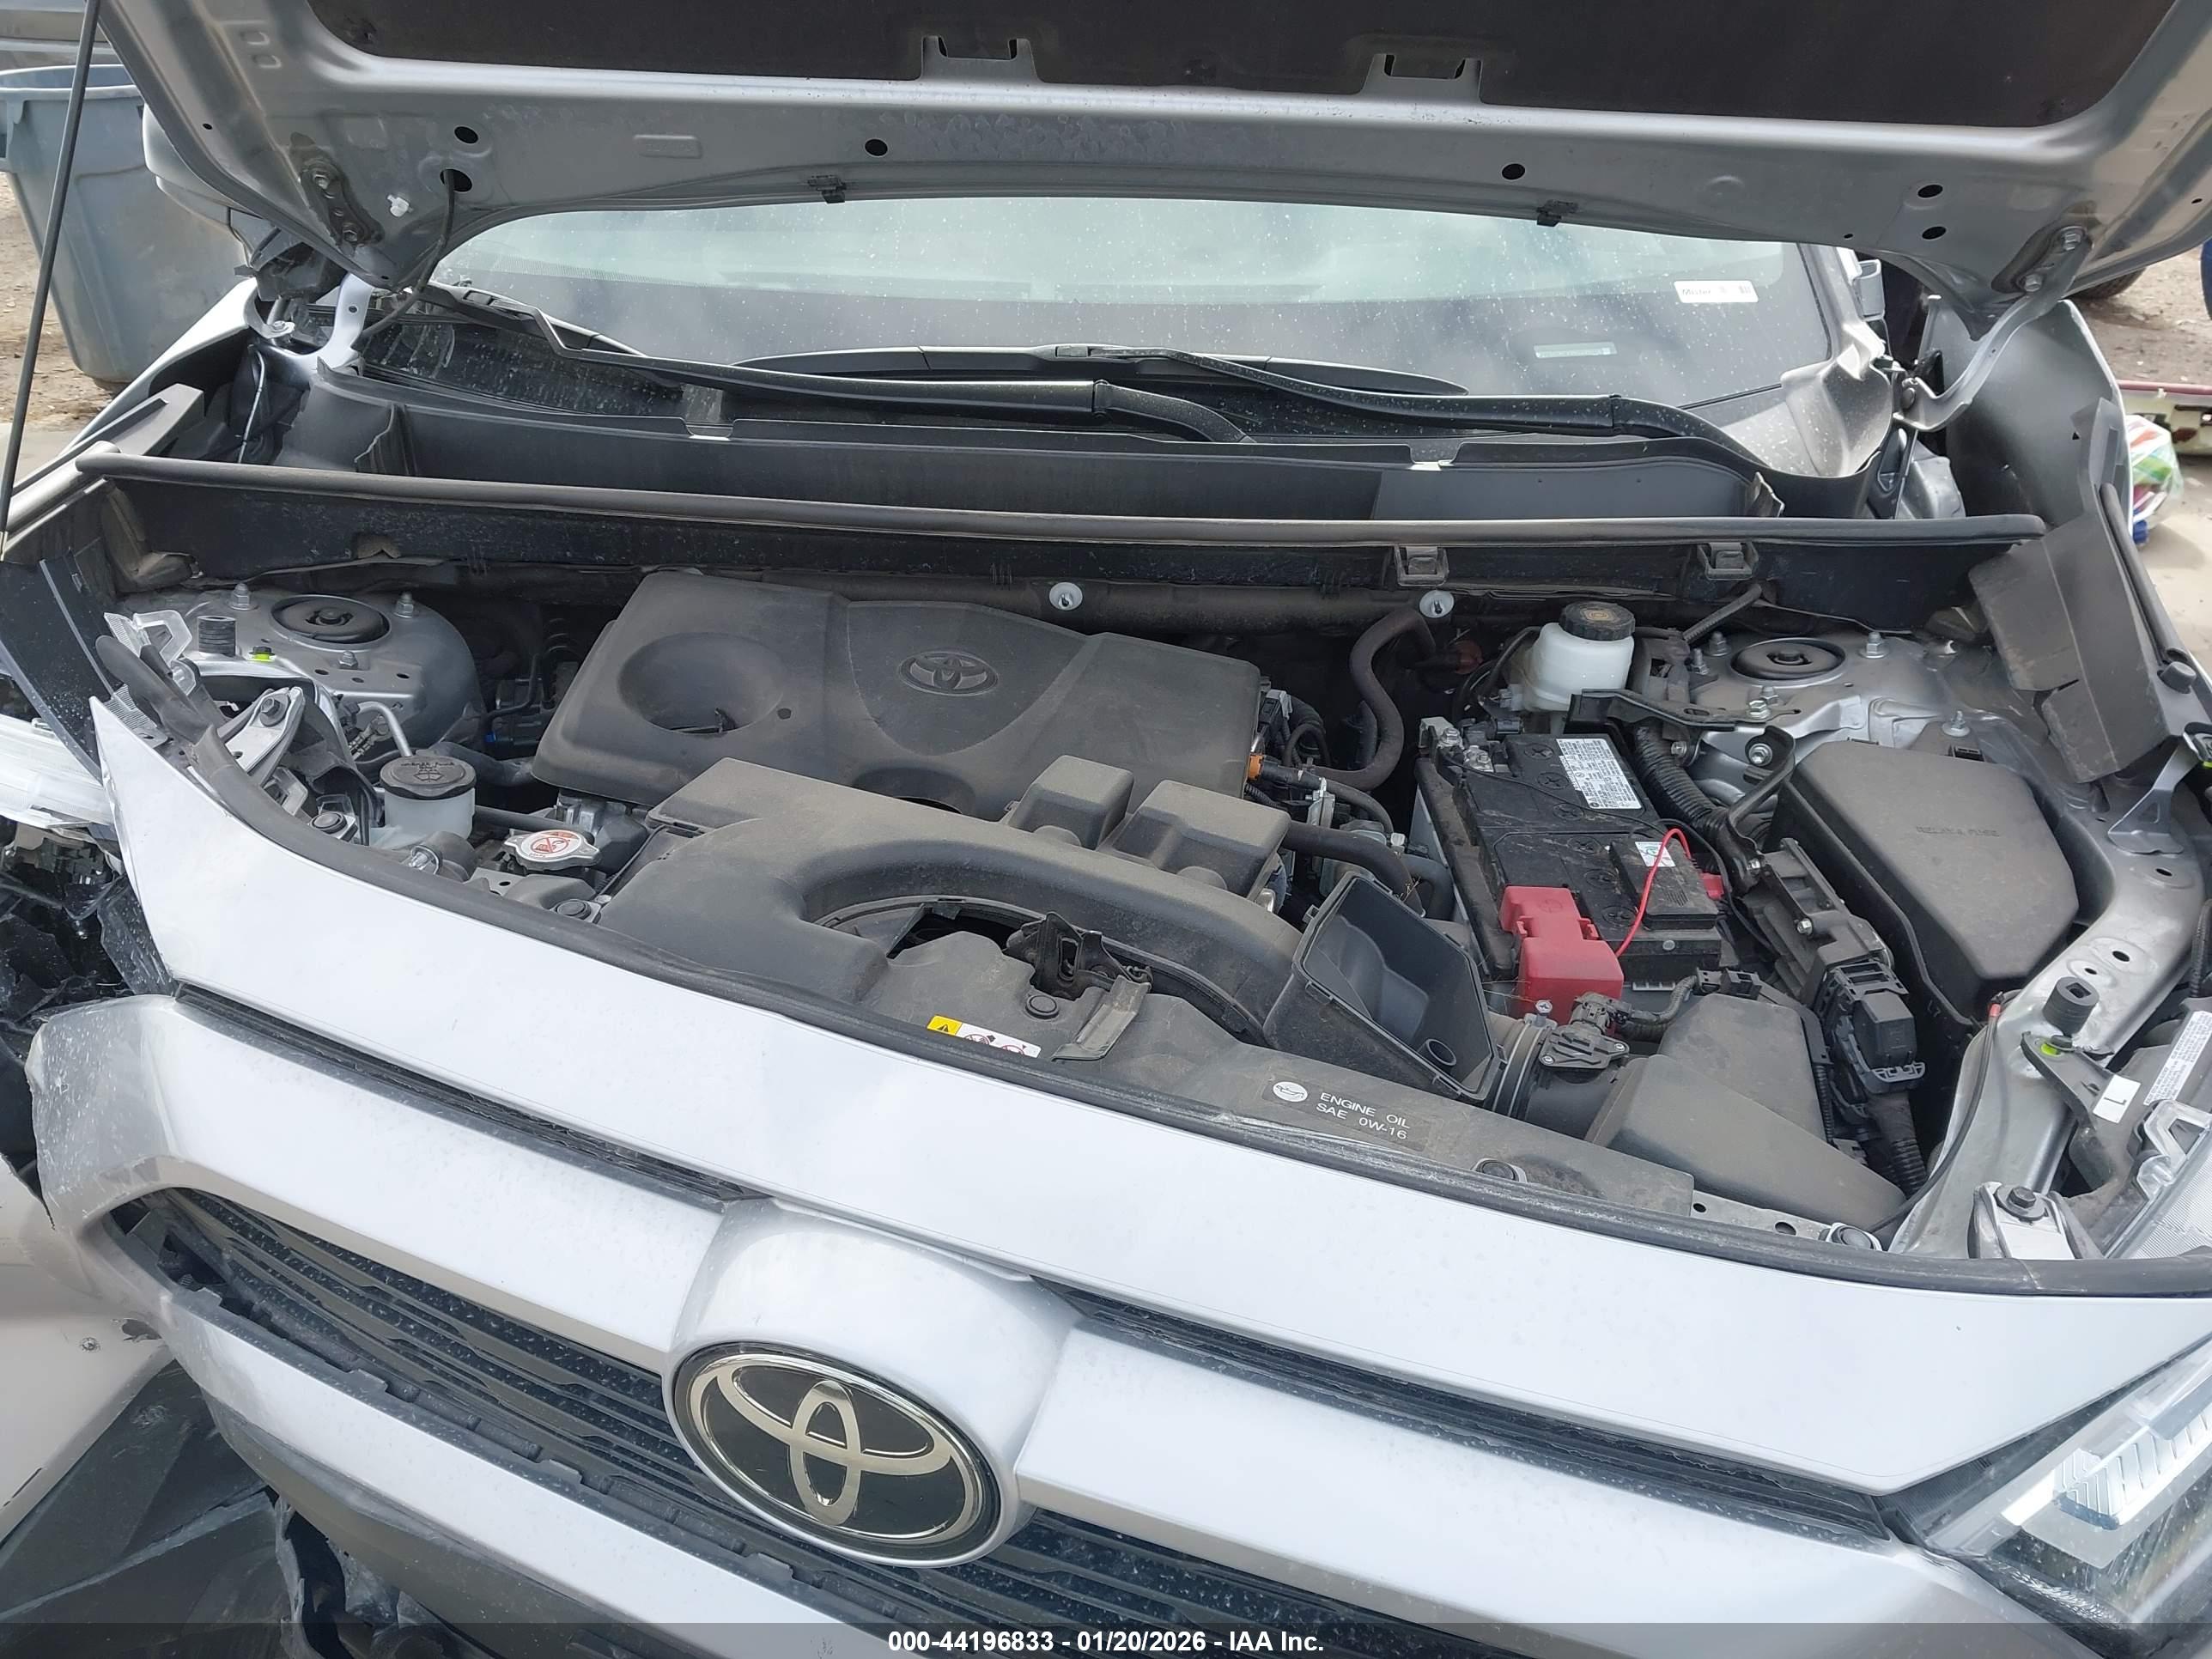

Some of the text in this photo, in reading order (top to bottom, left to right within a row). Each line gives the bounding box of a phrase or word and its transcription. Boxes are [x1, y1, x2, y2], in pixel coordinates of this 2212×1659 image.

[1320, 1092, 1411, 1129] ENGINE OIL
[2104, 1097, 2126, 1106] L
[1316, 1103, 1408, 1139] SAE 0W-16
